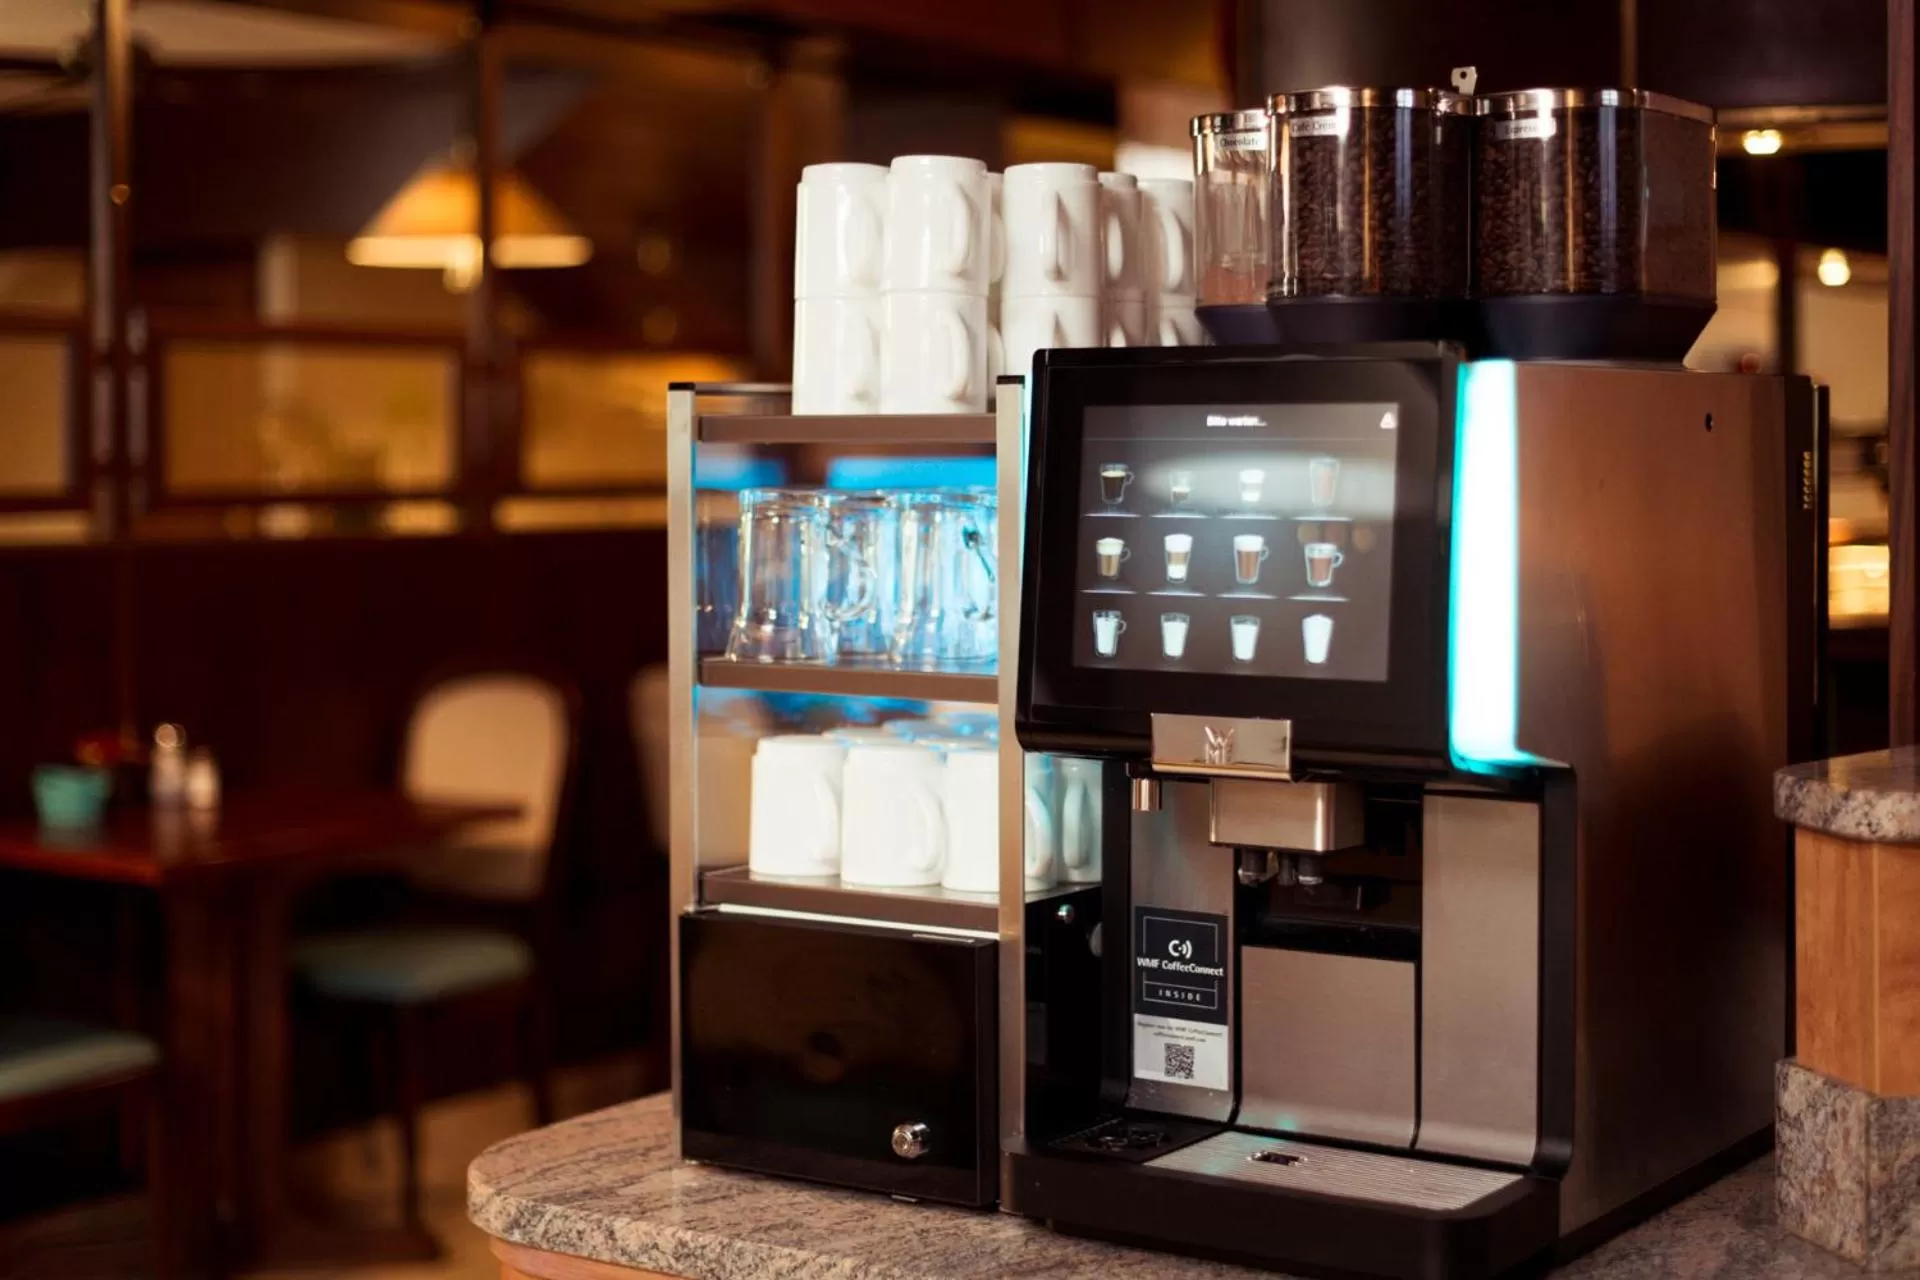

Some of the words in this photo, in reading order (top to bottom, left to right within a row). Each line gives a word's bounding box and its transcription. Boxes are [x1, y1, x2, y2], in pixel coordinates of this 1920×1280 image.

[1136, 957, 1160, 969] WMF
[1161, 960, 1224, 976] CoffeeConnect
[1159, 989, 1200, 1001] INSIDE
